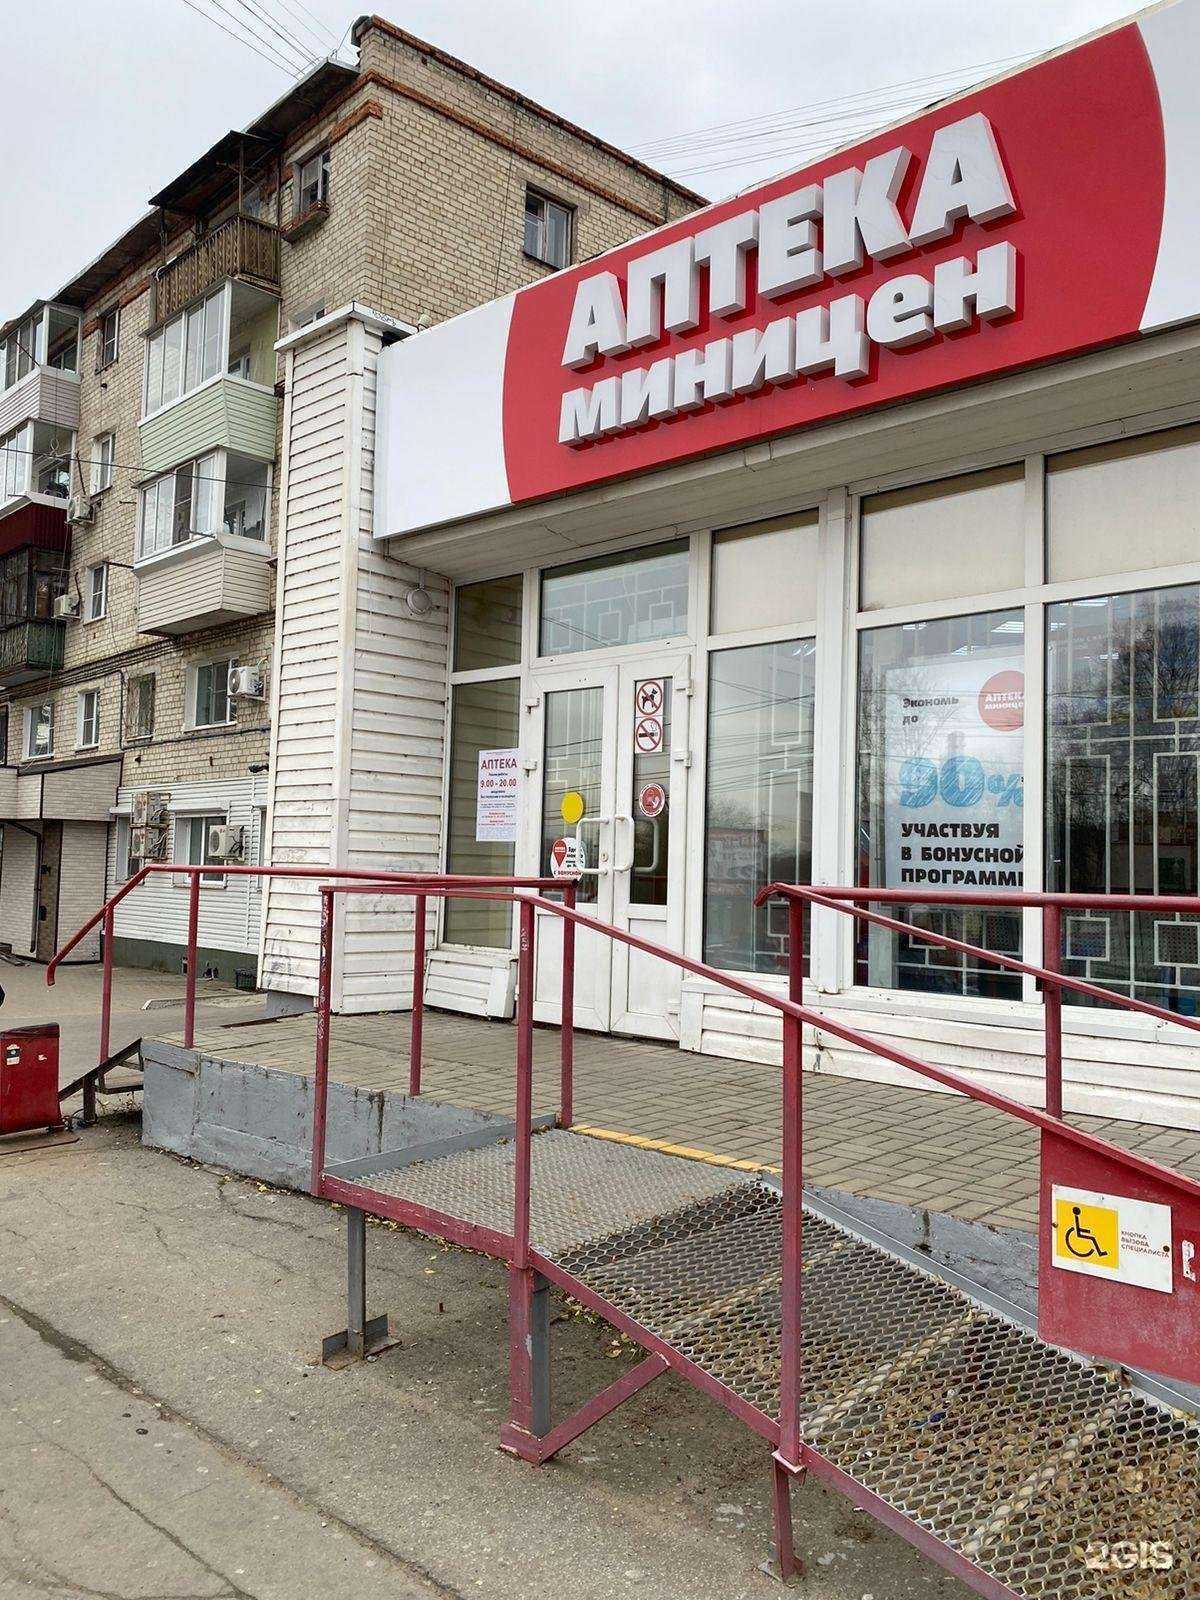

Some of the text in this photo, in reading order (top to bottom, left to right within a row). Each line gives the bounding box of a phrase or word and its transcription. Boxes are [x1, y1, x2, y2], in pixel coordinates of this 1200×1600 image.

[561, 112, 1017, 368] АПТЕКА
[902, 715, 919, 726] до
[481, 758, 518, 770] АПТЕКА
[901, 823, 999, 838] УЧАСТВУЯ
[901, 846, 912, 860] В
[1121, 1230, 1147, 1240] КНОПКА
[1121, 1237, 1149, 1247] ВЫЗОВА
[1121, 1243, 1170, 1258] СПЕЦИАЛИСТА
